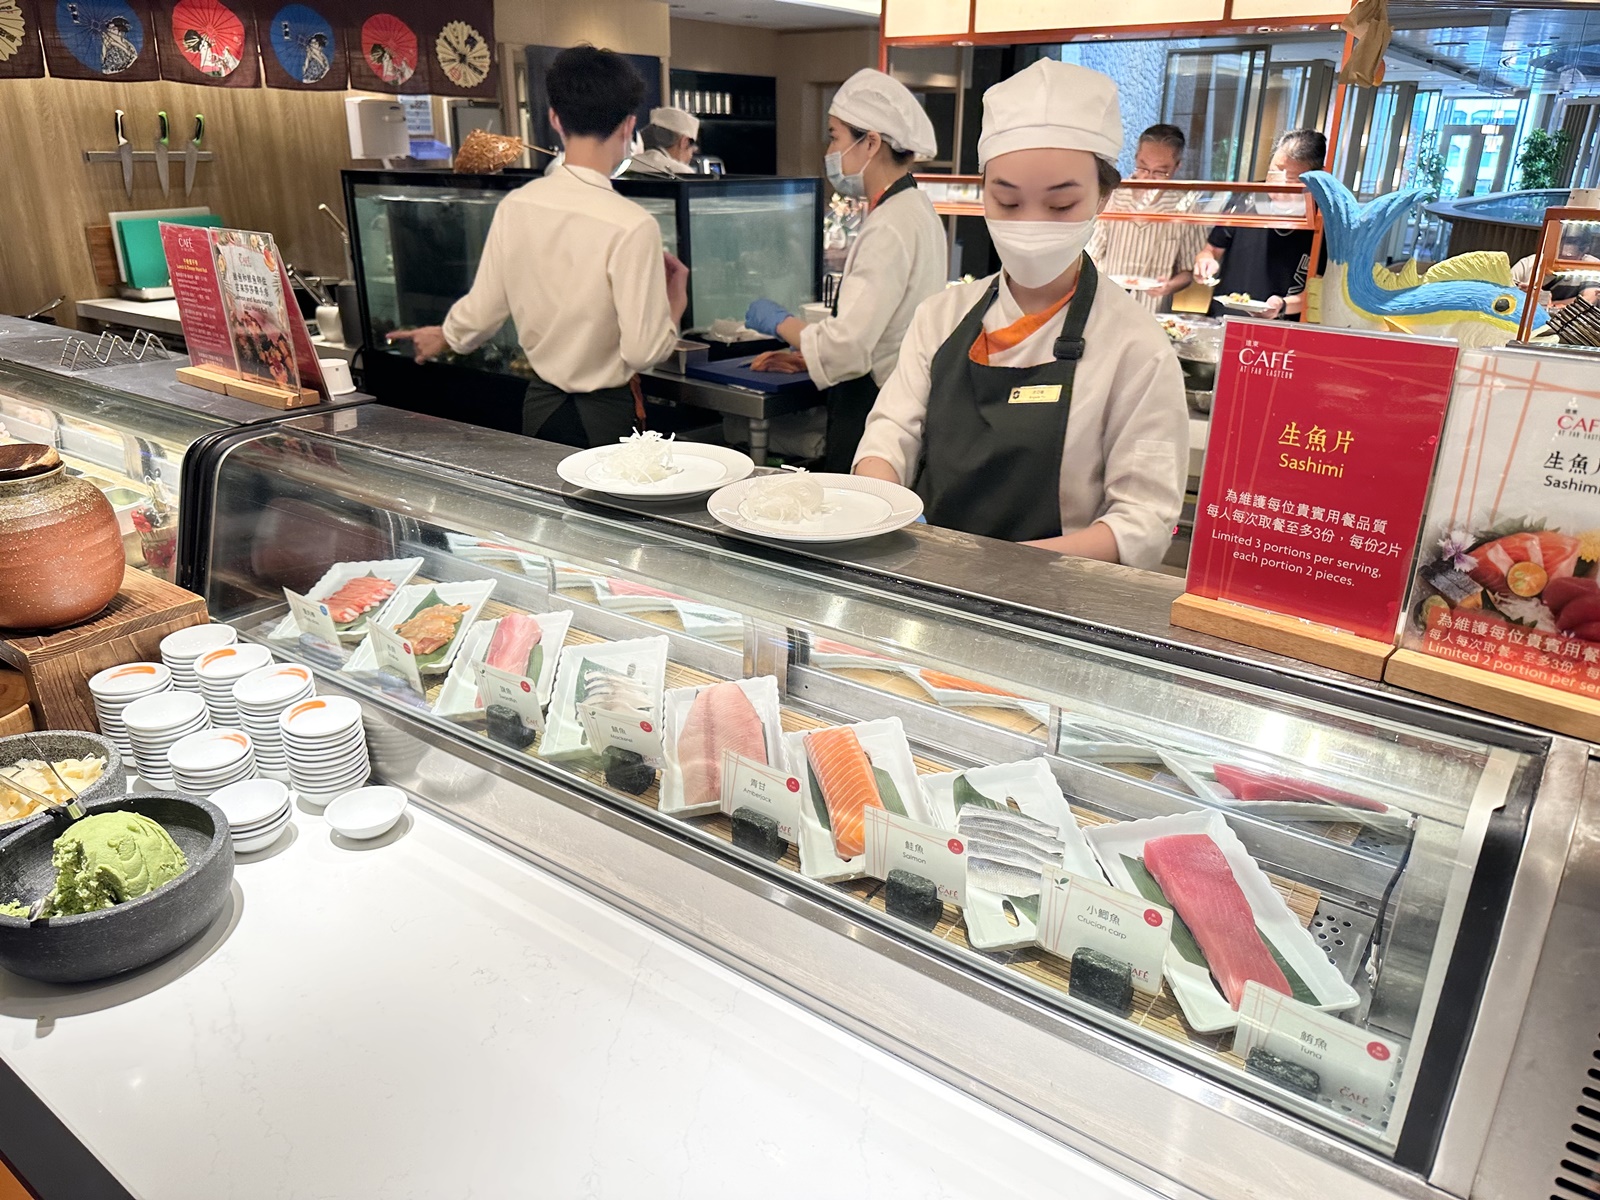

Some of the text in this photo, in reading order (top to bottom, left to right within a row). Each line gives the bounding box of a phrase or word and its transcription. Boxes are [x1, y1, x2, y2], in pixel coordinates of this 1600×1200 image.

[1238, 347, 1296, 371] CAFÉ
[1240, 365, 1293, 379] AT FAR EASTERN
[1557, 414, 1600, 433] CAF
[1277, 421, 1355, 454] 生魚片
[1279, 453, 1344, 478] Sashimi
[1211, 528, 1382, 578] Limited 3 portions per serving,
[1232, 549, 1355, 587] each portion 2 pieces.
[1428, 641, 1600, 694] Limited 2 portion per ser
[902, 851, 927, 864] Salmon
[1077, 914, 1127, 940] Crucian carp
[1131, 968, 1149, 979] AFÉ
[1300, 1045, 1322, 1060] Tuna
